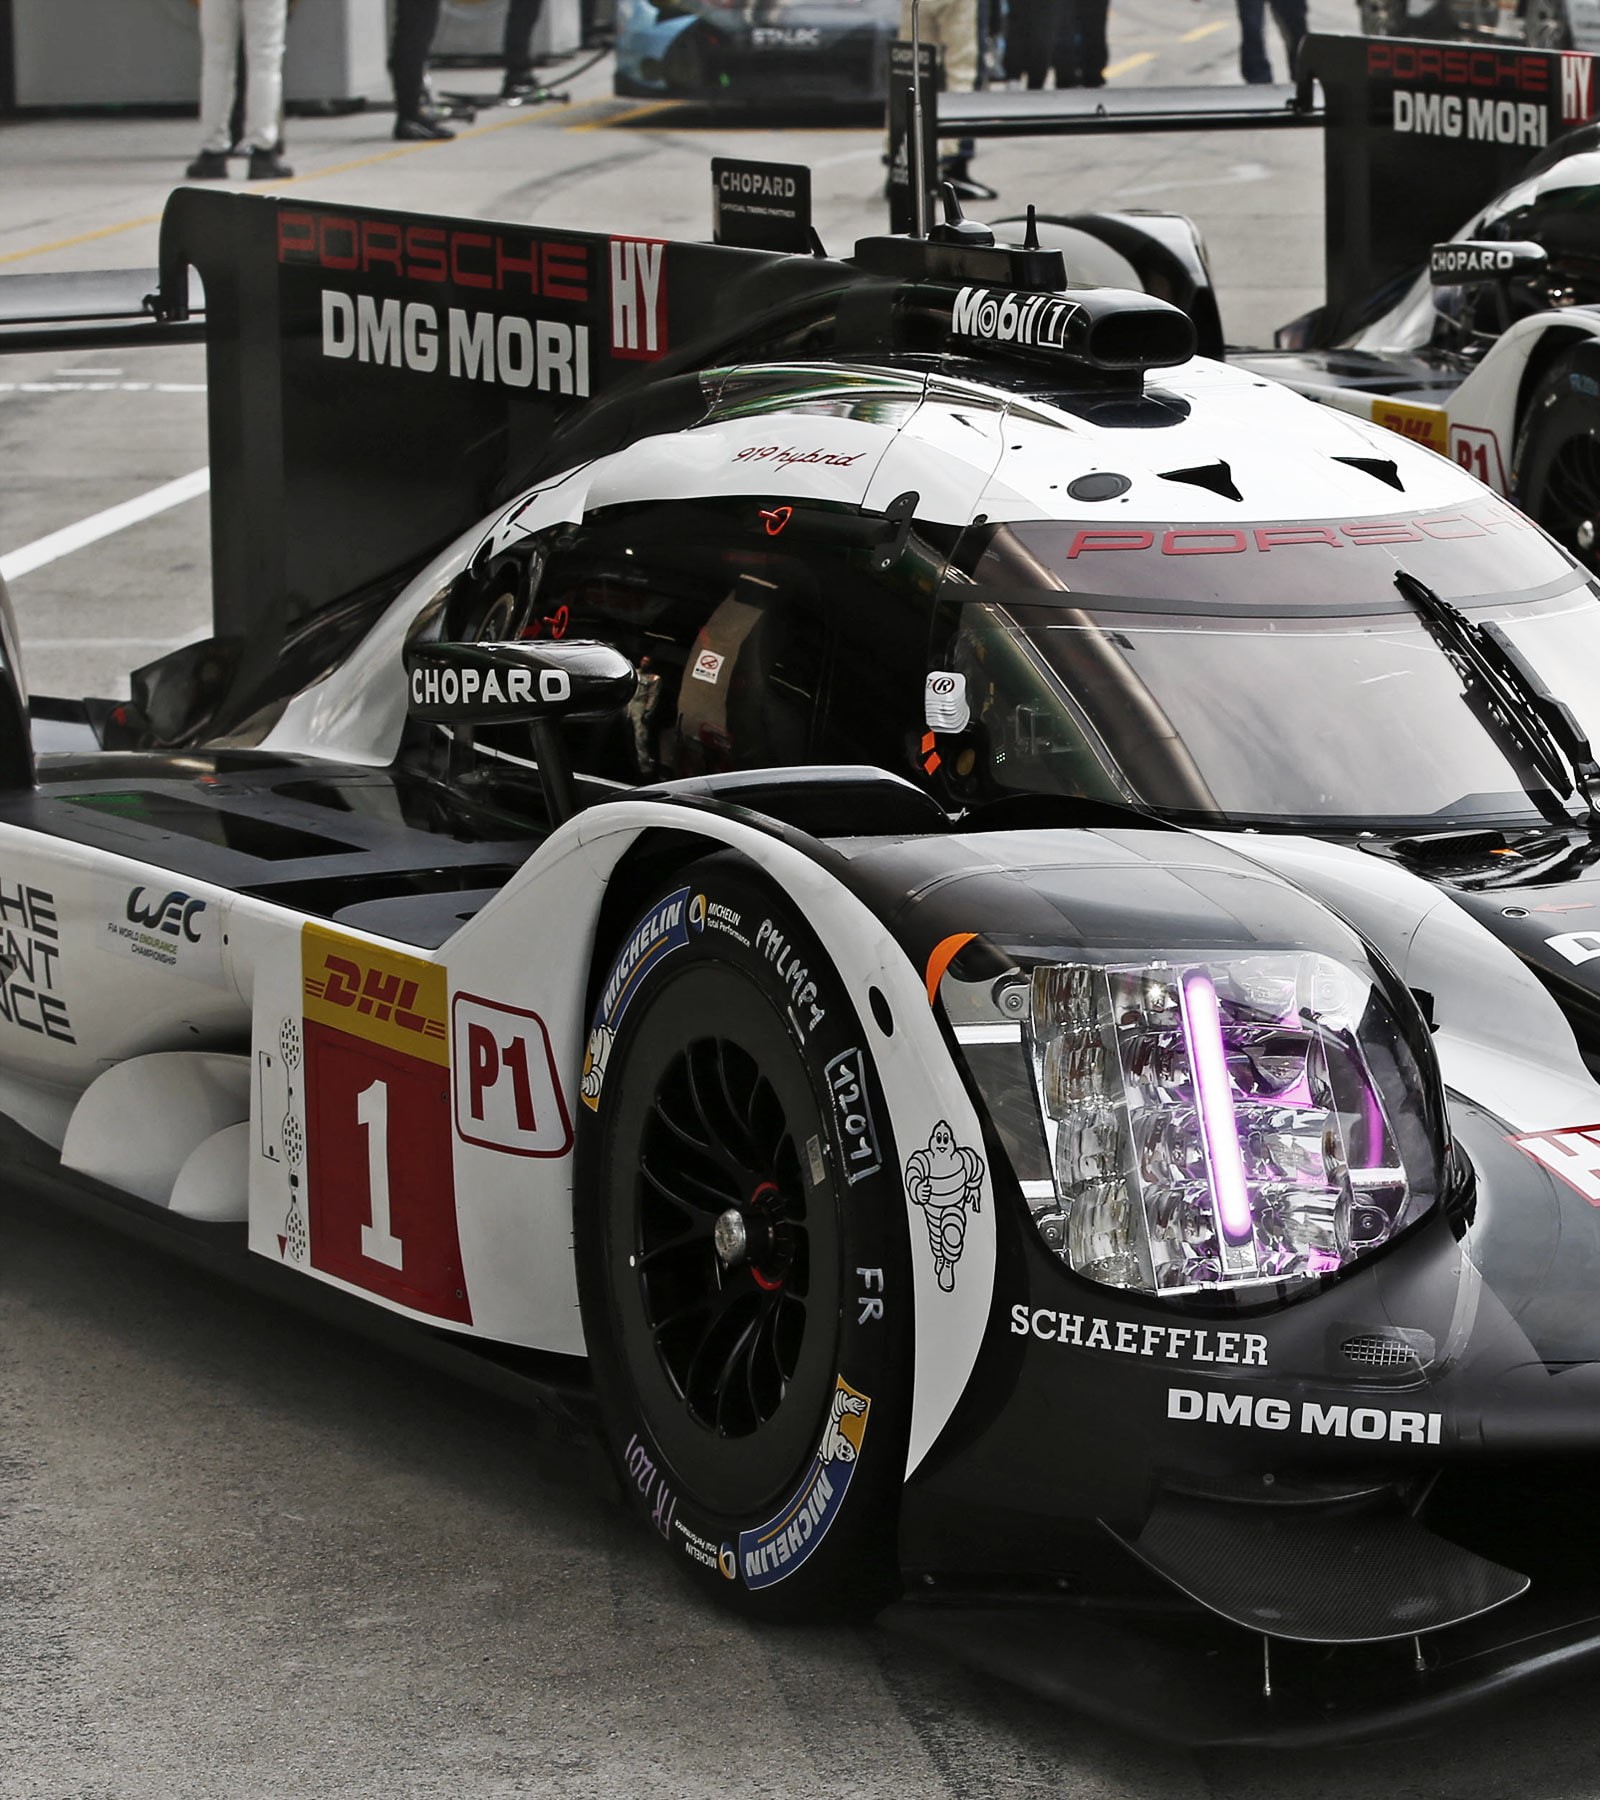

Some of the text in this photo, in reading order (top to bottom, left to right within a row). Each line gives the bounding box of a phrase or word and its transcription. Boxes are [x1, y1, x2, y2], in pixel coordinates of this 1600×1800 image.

[1366, 44, 1549, 91] PORSCHE
[1561, 53, 1592, 122] HY
[1393, 90, 1548, 147] DMG MORI
[720, 171, 796, 197] CHOPARD
[277, 211, 589, 300] PORSCHE
[1430, 249, 1514, 273] CHOPARD
[610, 240, 665, 352] HY
[951, 285, 1043, 346] Mobil
[321, 289, 590, 397] DMG MORI
[732, 446, 867, 472] 919 hybrid
[1066, 508, 1536, 559] PORSCH
[411, 667, 573, 705] CHOPARD
[0, 876, 58, 940] HE
[107, 922, 118, 933] FIA
[119, 926, 139, 941] WORLD
[127, 886, 207, 943] WEC
[707, 902, 741, 927] MICHELIN
[707, 917, 751, 948] Total Performance
[0, 924, 59, 990] NT
[603, 900, 684, 1020] MICHELIN
[322, 953, 431, 1035] DHL
[467, 1022, 538, 1133] P1
[834, 1064, 873, 1161] 1201
[357, 1078, 404, 1273] 1
[855, 1266, 884, 1325] FR
[1010, 1303, 1269, 1367] SCHAEFFLER
[1167, 1388, 1442, 1445] DMG MORI
[745, 1468, 834, 1579] MICHELIN
[685, 1541, 718, 1570] MICHELIN
